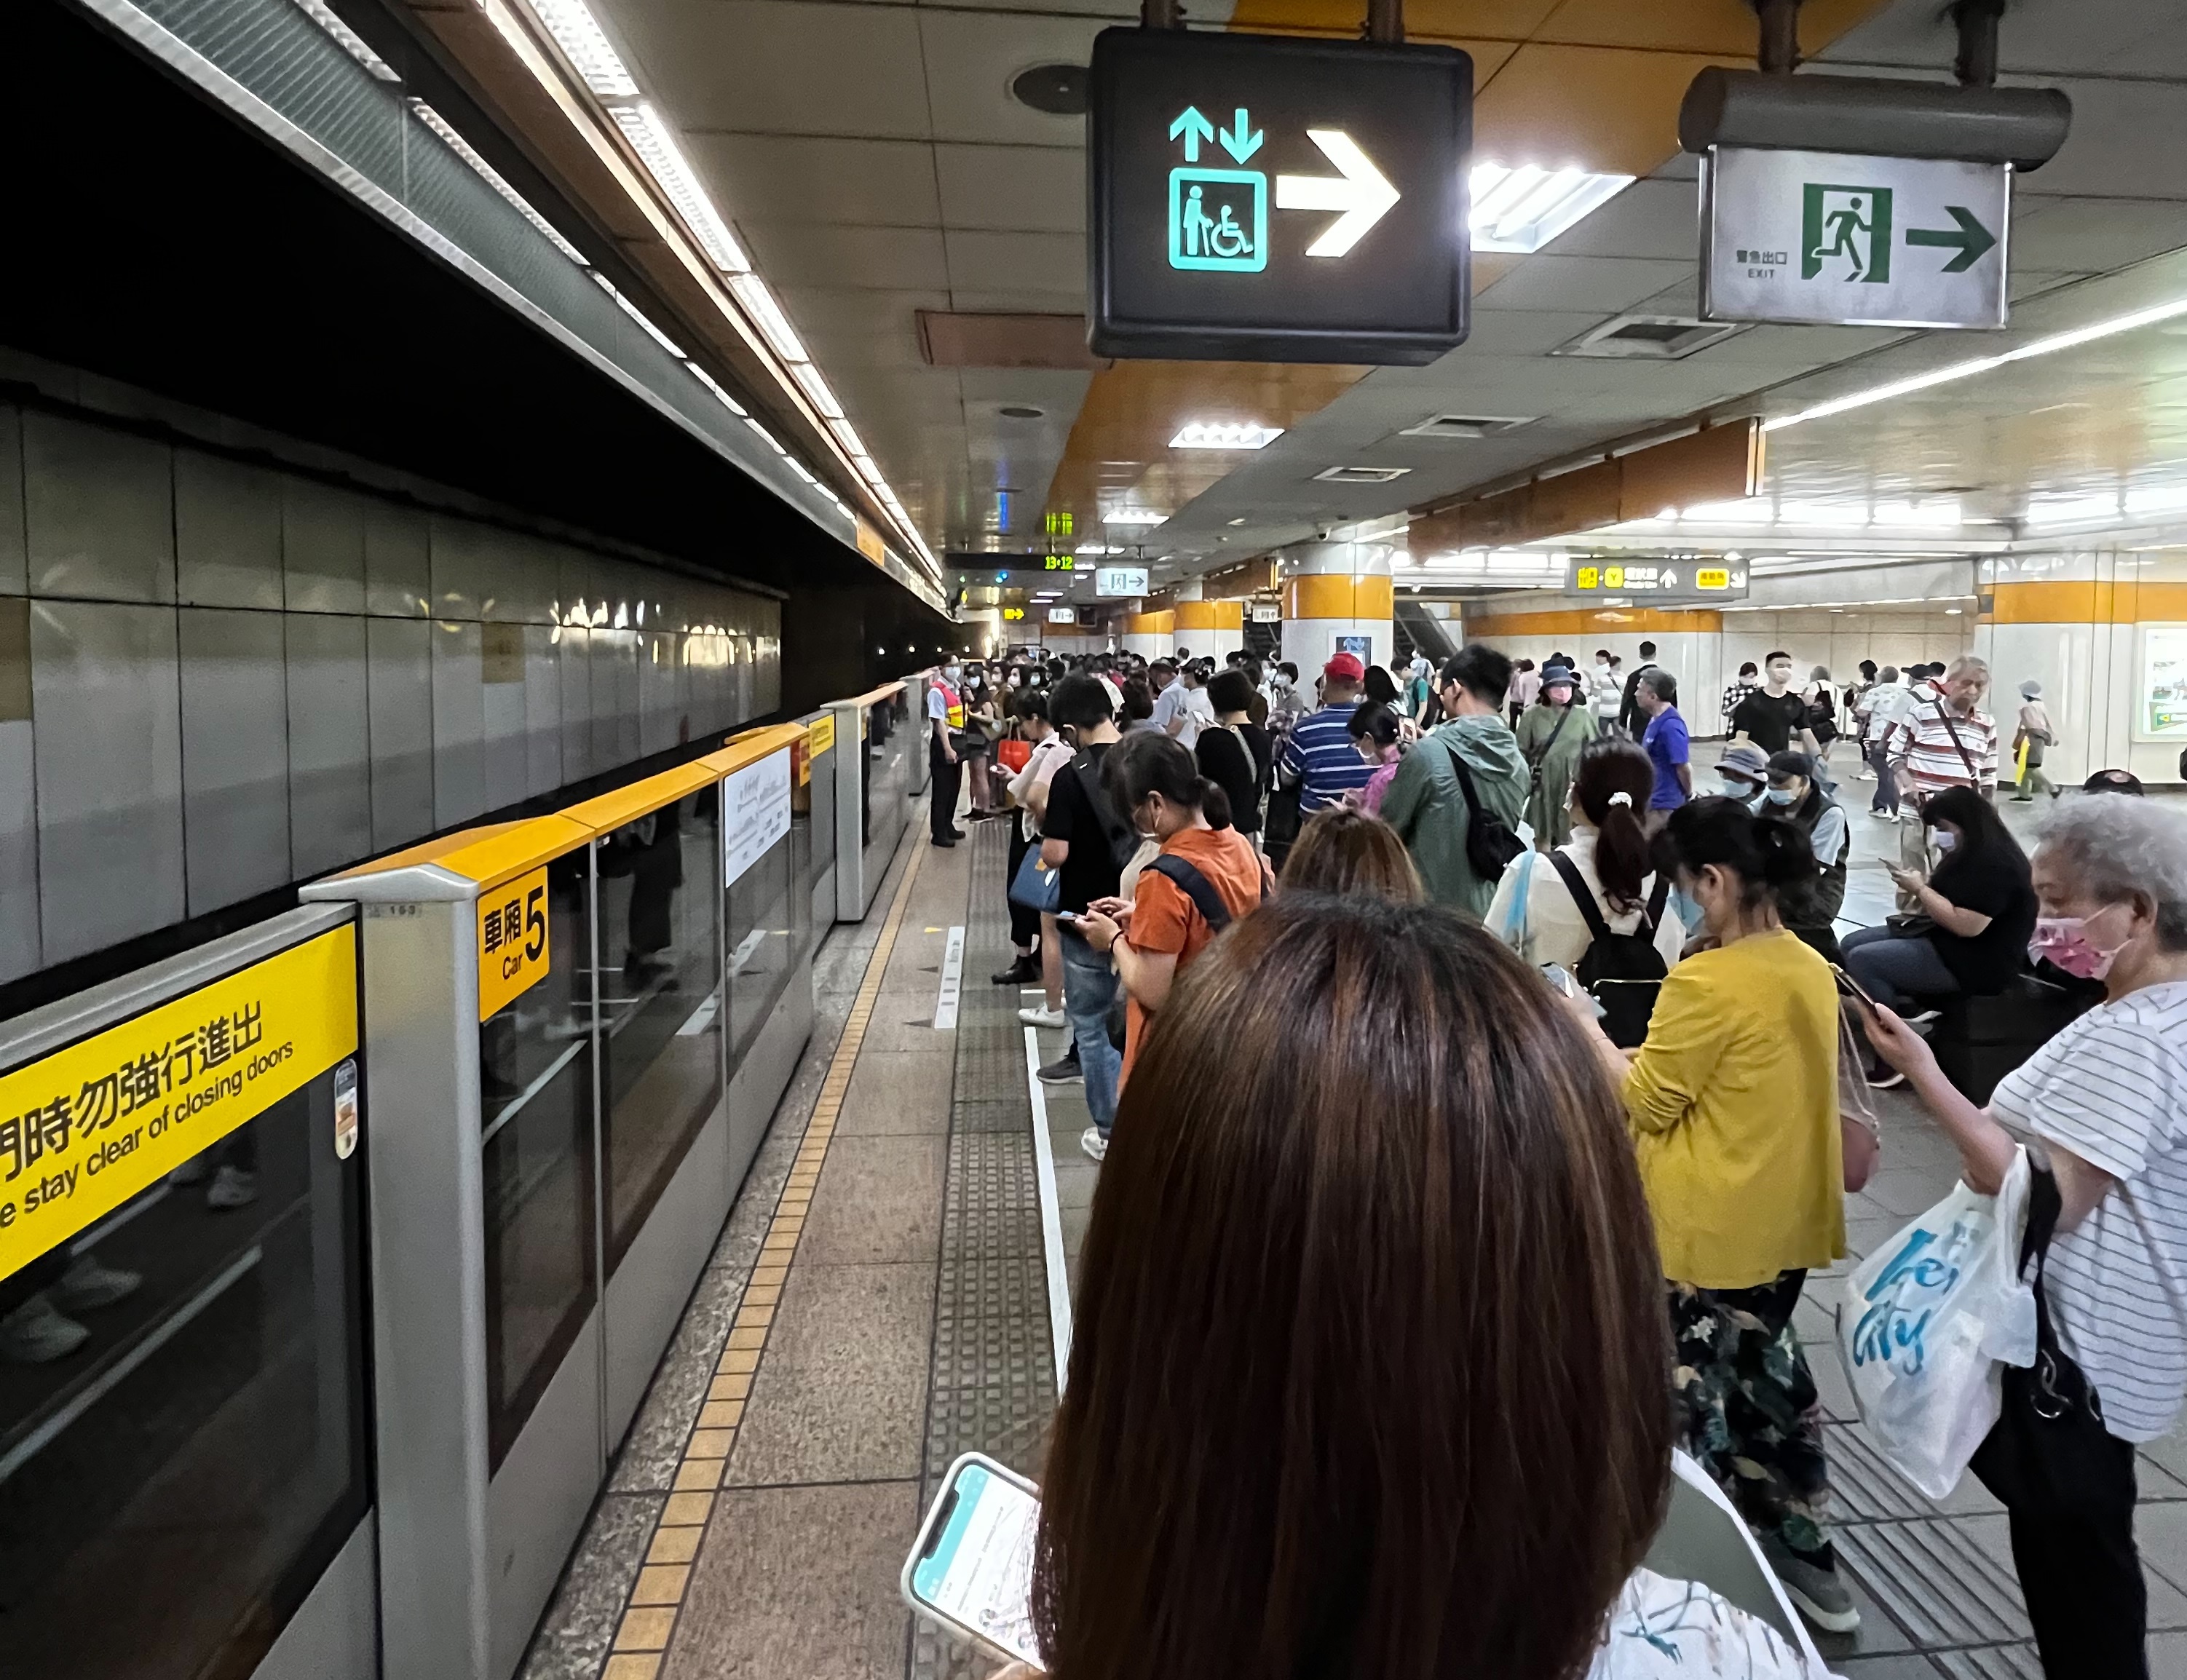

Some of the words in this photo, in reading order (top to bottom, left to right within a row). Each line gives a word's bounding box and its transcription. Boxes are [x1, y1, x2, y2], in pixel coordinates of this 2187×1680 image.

[1737, 250, 1788, 265] 出口
[1747, 268, 1775, 279] EXIT
[1045, 555, 1073, 571] 13:12
[484, 897, 521, 954] 車廂
[525, 884, 545, 962] 5
[502, 953, 523, 980] Car
[24, 1162, 80, 1215] stay
[86, 1125, 143, 1177] clear
[148, 1104, 170, 1139] of
[174, 1069, 243, 1124] closing
[246, 1040, 294, 1082] doors
